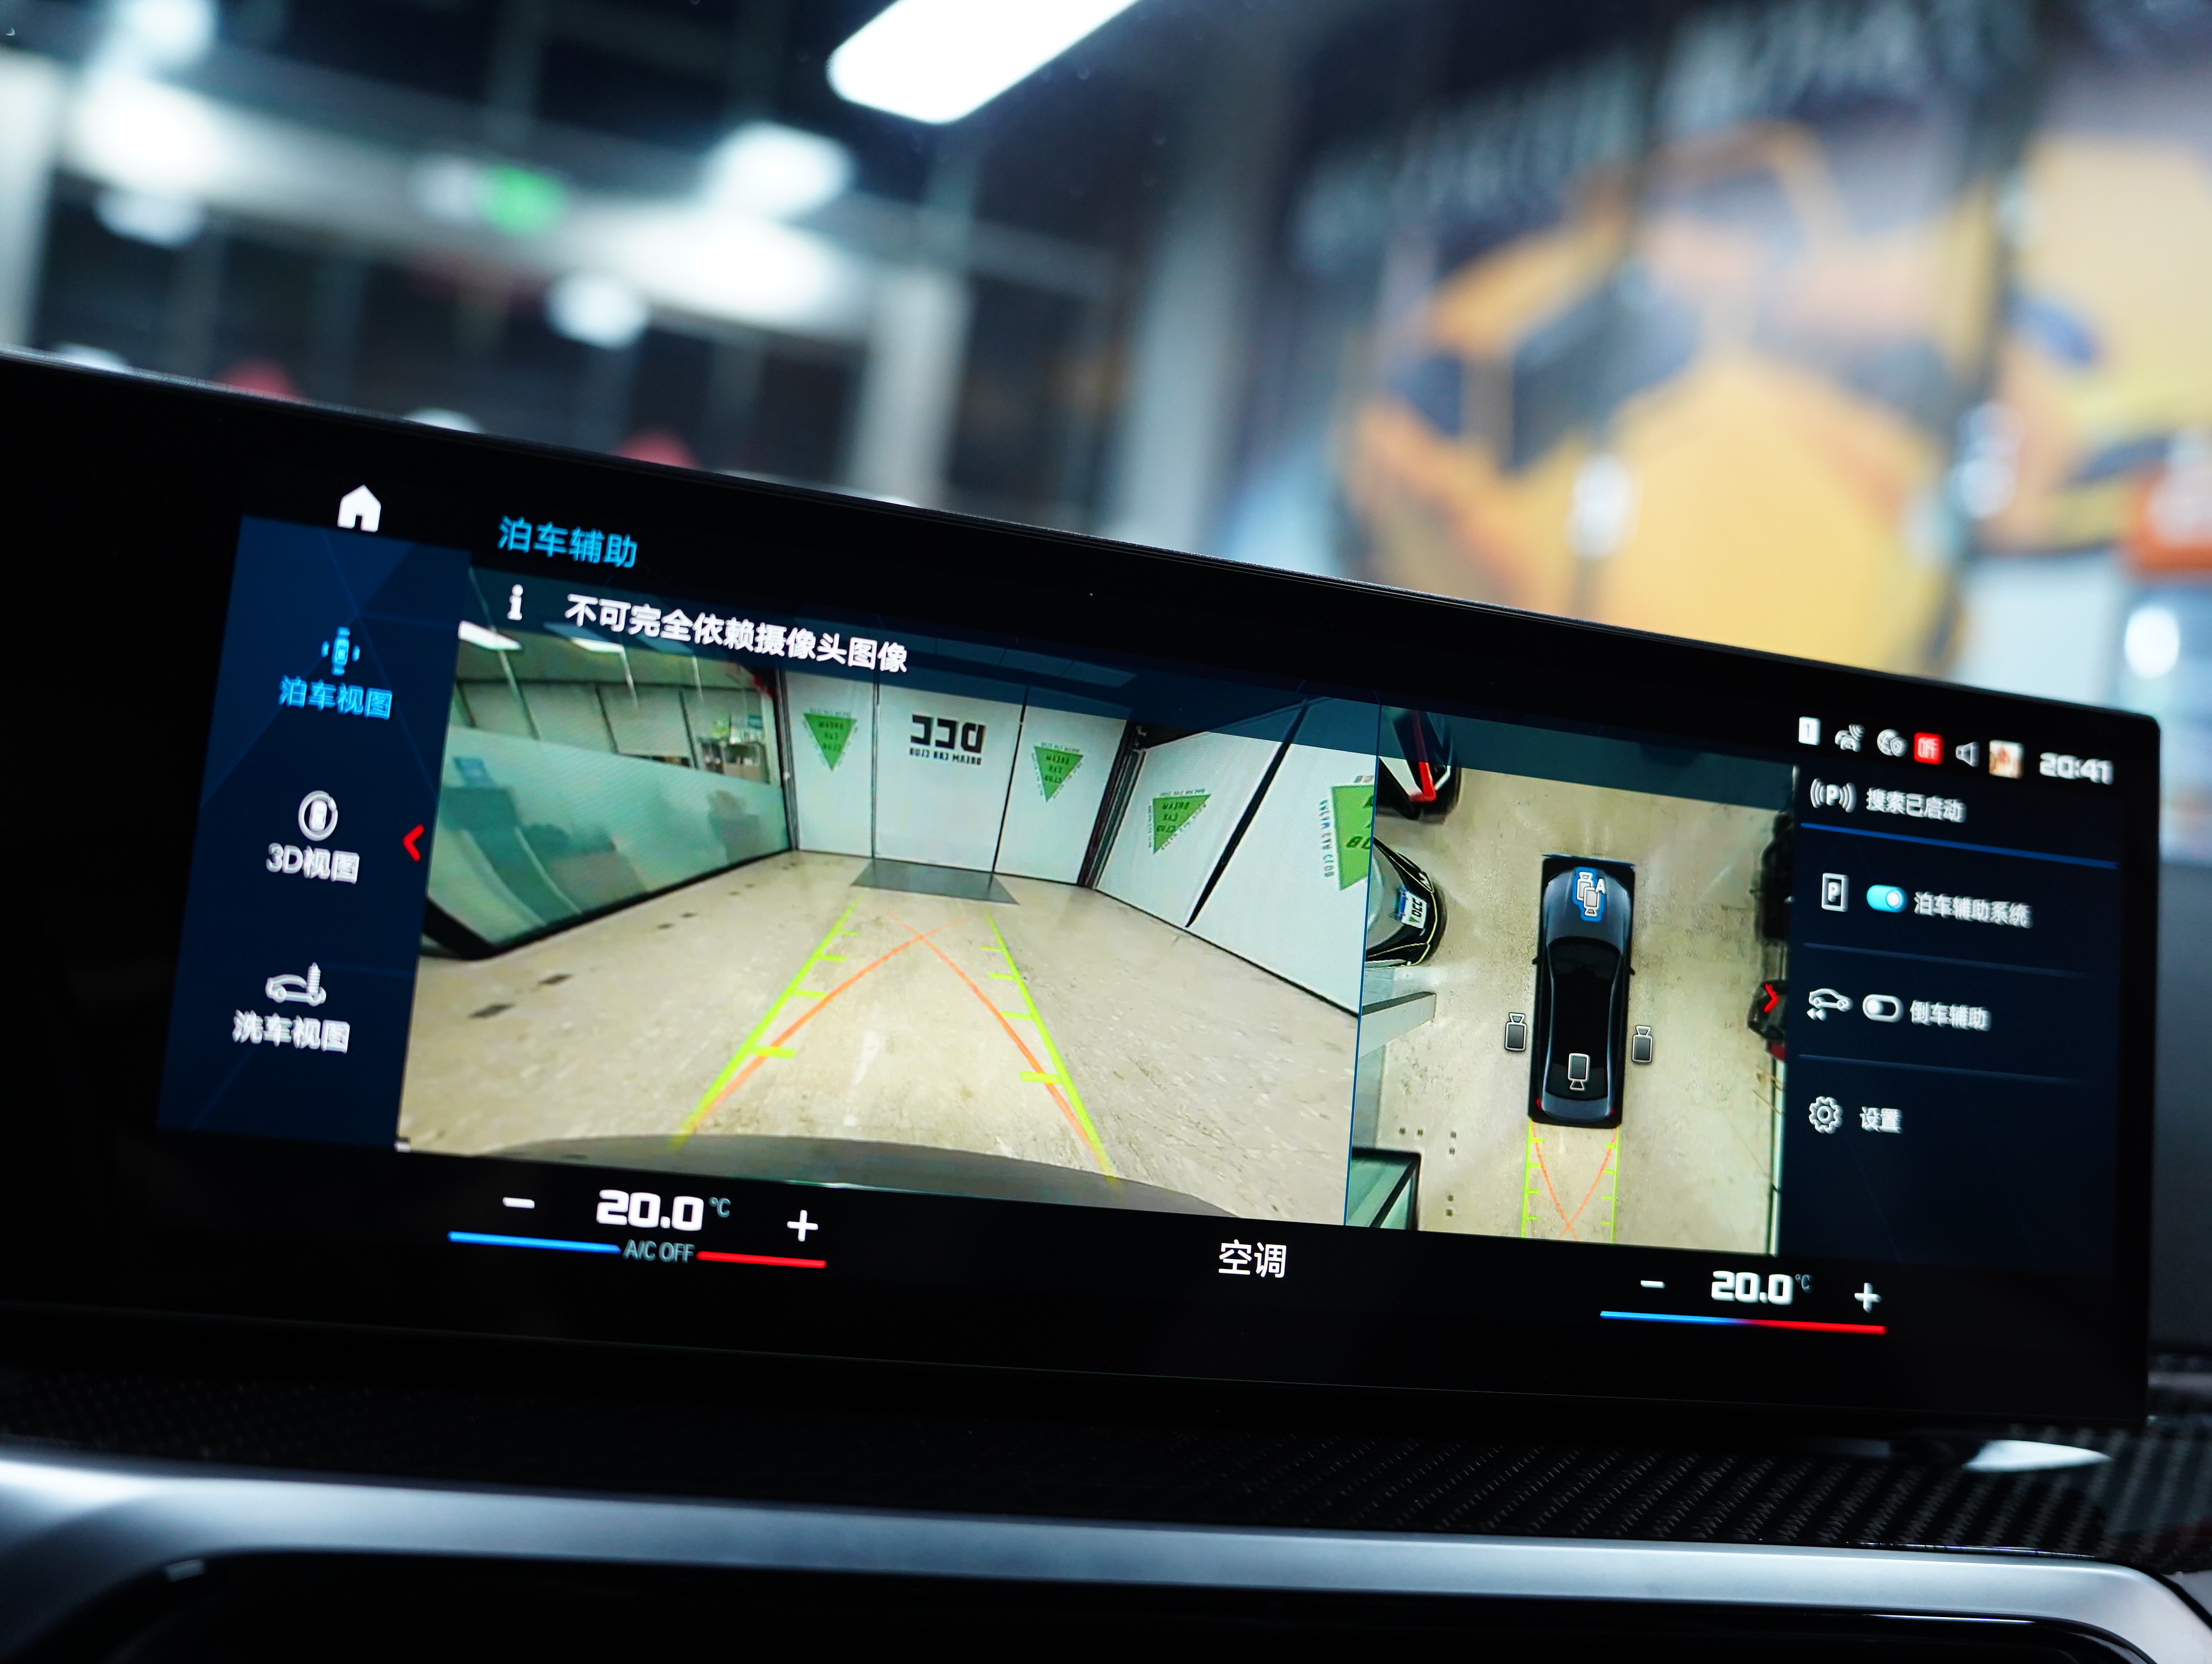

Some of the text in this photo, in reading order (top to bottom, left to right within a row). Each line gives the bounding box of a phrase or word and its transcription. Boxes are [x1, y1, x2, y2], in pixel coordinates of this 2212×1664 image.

[498, 516, 638, 568] 泊车辅助
[566, 594, 908, 673] 不可完全依赖摄像头图像
[278, 675, 393, 721] 泊车视图
[2040, 752, 2114, 785] 20:41
[1826, 784, 1840, 806] P
[1866, 787, 1967, 823] 搜索已启动
[266, 842, 360, 885] 3D视图
[1594, 878, 1606, 894] A
[1914, 891, 2033, 929] 泊车辅助系统
[231, 1010, 351, 1054] 洗车视图
[1910, 999, 1991, 1031] 倒车辅助
[1859, 1106, 1903, 1134] 设置
[596, 1189, 705, 1232] 20.0
[623, 1238, 696, 1263] A/C OFF
[1218, 1238, 1287, 1278] 空调
[1711, 1270, 1793, 1305] 20.0
